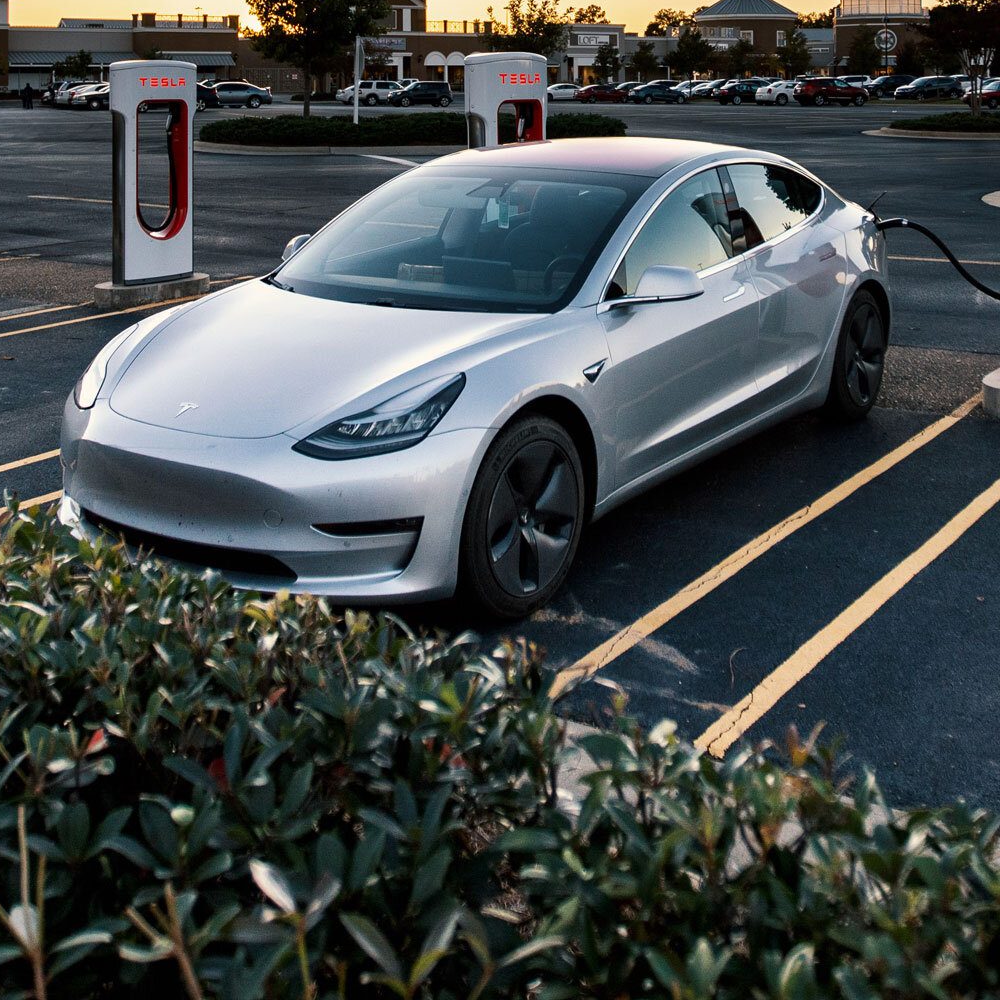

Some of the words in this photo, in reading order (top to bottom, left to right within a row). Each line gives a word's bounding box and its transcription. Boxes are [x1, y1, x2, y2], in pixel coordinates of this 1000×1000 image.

[579, 36, 599, 45] LOFT
[139, 77, 186, 87] TESLA
[499, 73, 541, 84] TESLA
